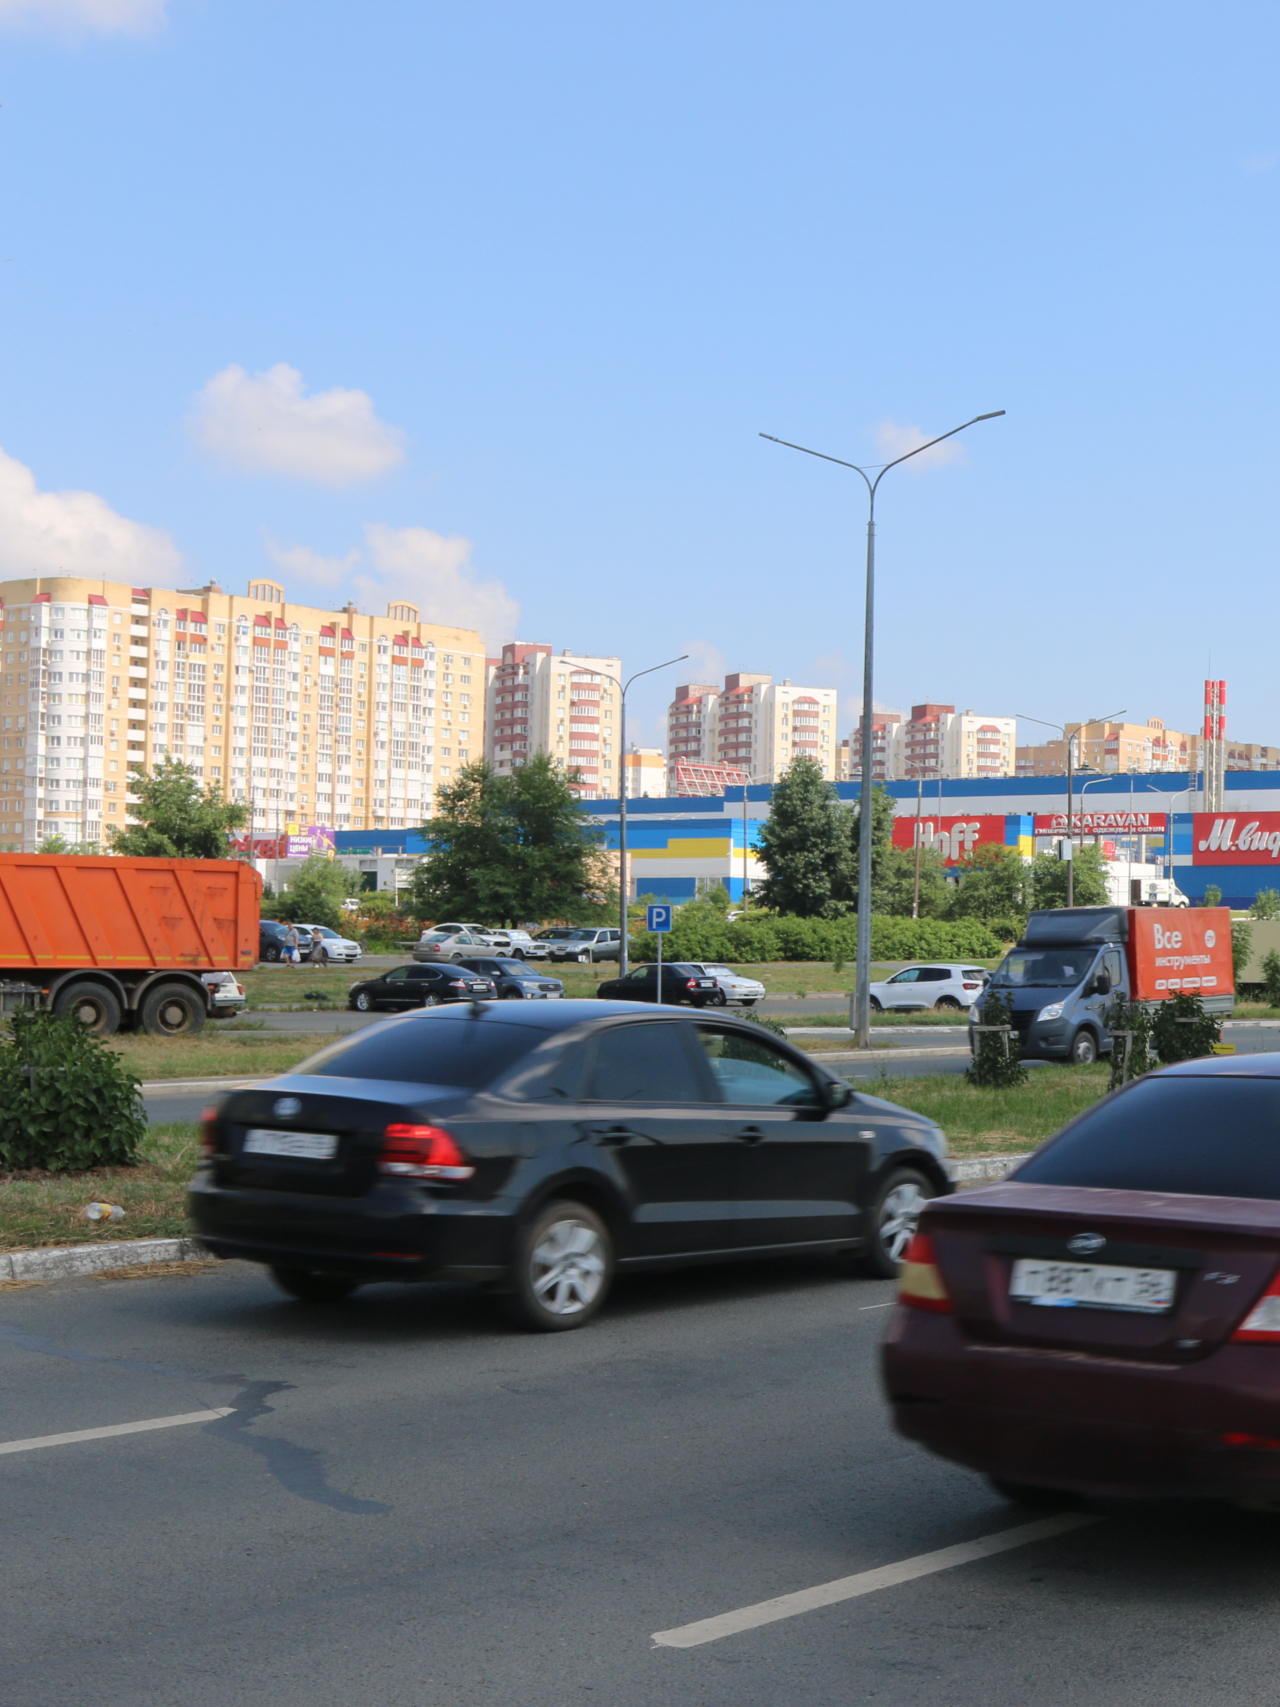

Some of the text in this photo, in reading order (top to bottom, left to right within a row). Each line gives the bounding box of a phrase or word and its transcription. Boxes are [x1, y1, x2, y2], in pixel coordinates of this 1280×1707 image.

[1071, 813, 1149, 827] KARAVAN
[290, 845, 309, 853] ЦЕНЫ
[913, 822, 980, 860] Hoff
[653, 908, 666, 929] P
[1153, 923, 1182, 949] Все
[1155, 955, 1211, 970] инструменты
